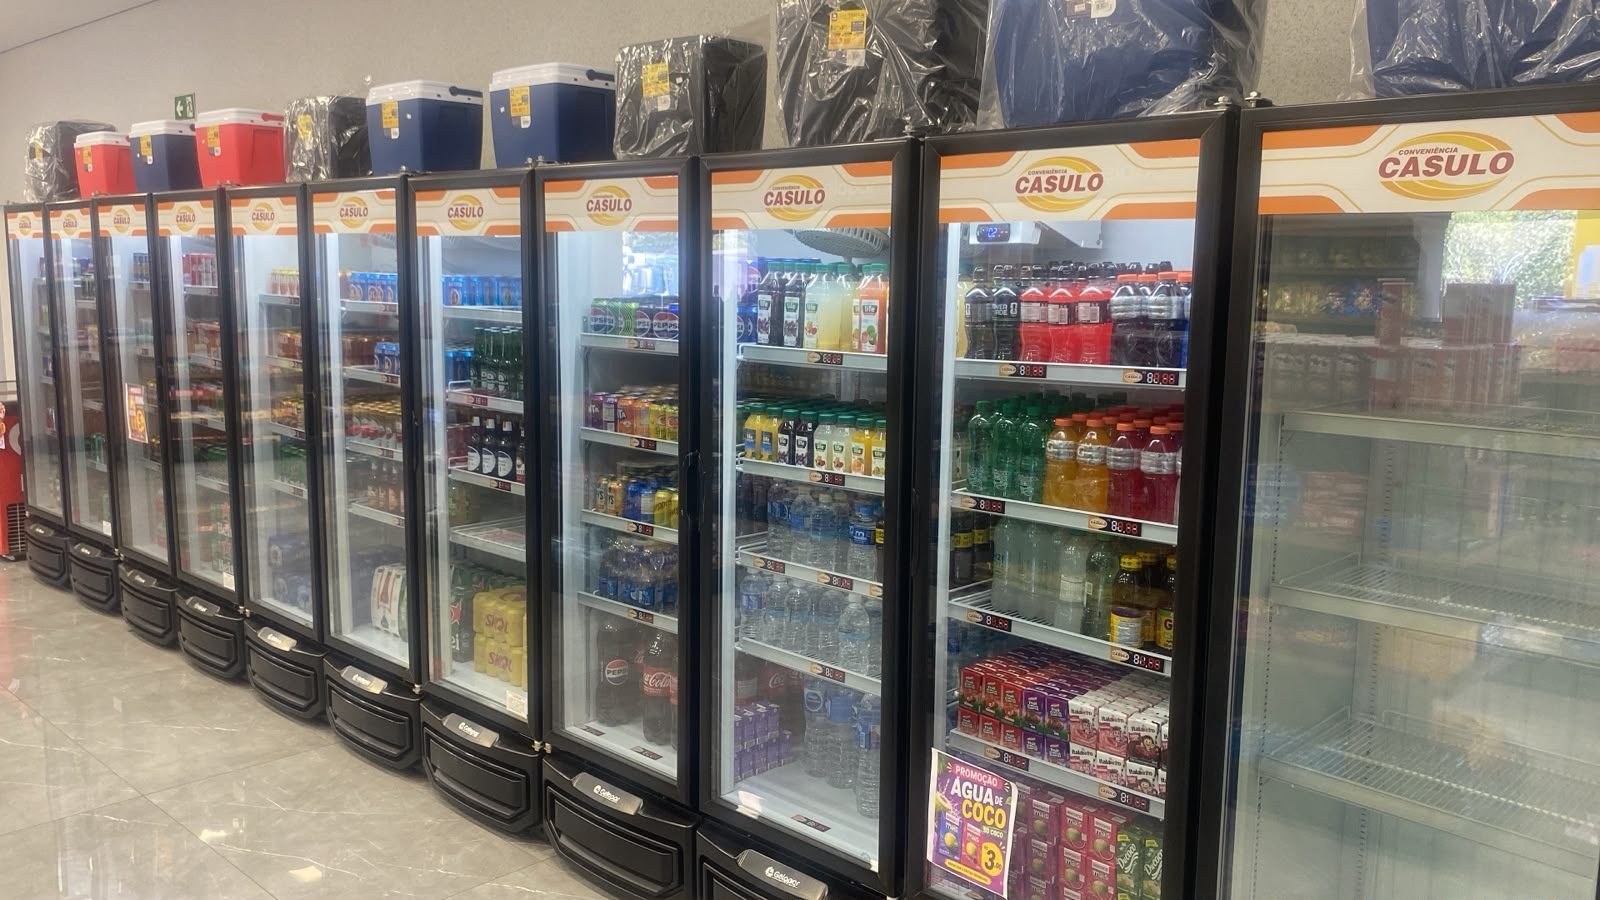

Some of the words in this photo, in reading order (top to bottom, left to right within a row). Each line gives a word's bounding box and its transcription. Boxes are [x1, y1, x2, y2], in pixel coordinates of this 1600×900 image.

[1398, 147, 1459, 156] CONVENIÊNCIA
[1378, 152, 1515, 179] CASULO
[1015, 173, 1104, 194] CASULO
[586, 198, 632, 213] CASULO
[763, 189, 827, 206] CASULO
[176, 214, 196, 223] CASULO
[252, 212, 275, 221] CASULO
[340, 207, 368, 218] CASULO
[448, 206, 483, 218] CASULO
[955, 765, 998, 788] PROMOÇÃO
[950, 776, 994, 806] ÁGUA
[995, 795, 1004, 806] DE
[962, 799, 1007, 829] COCO
